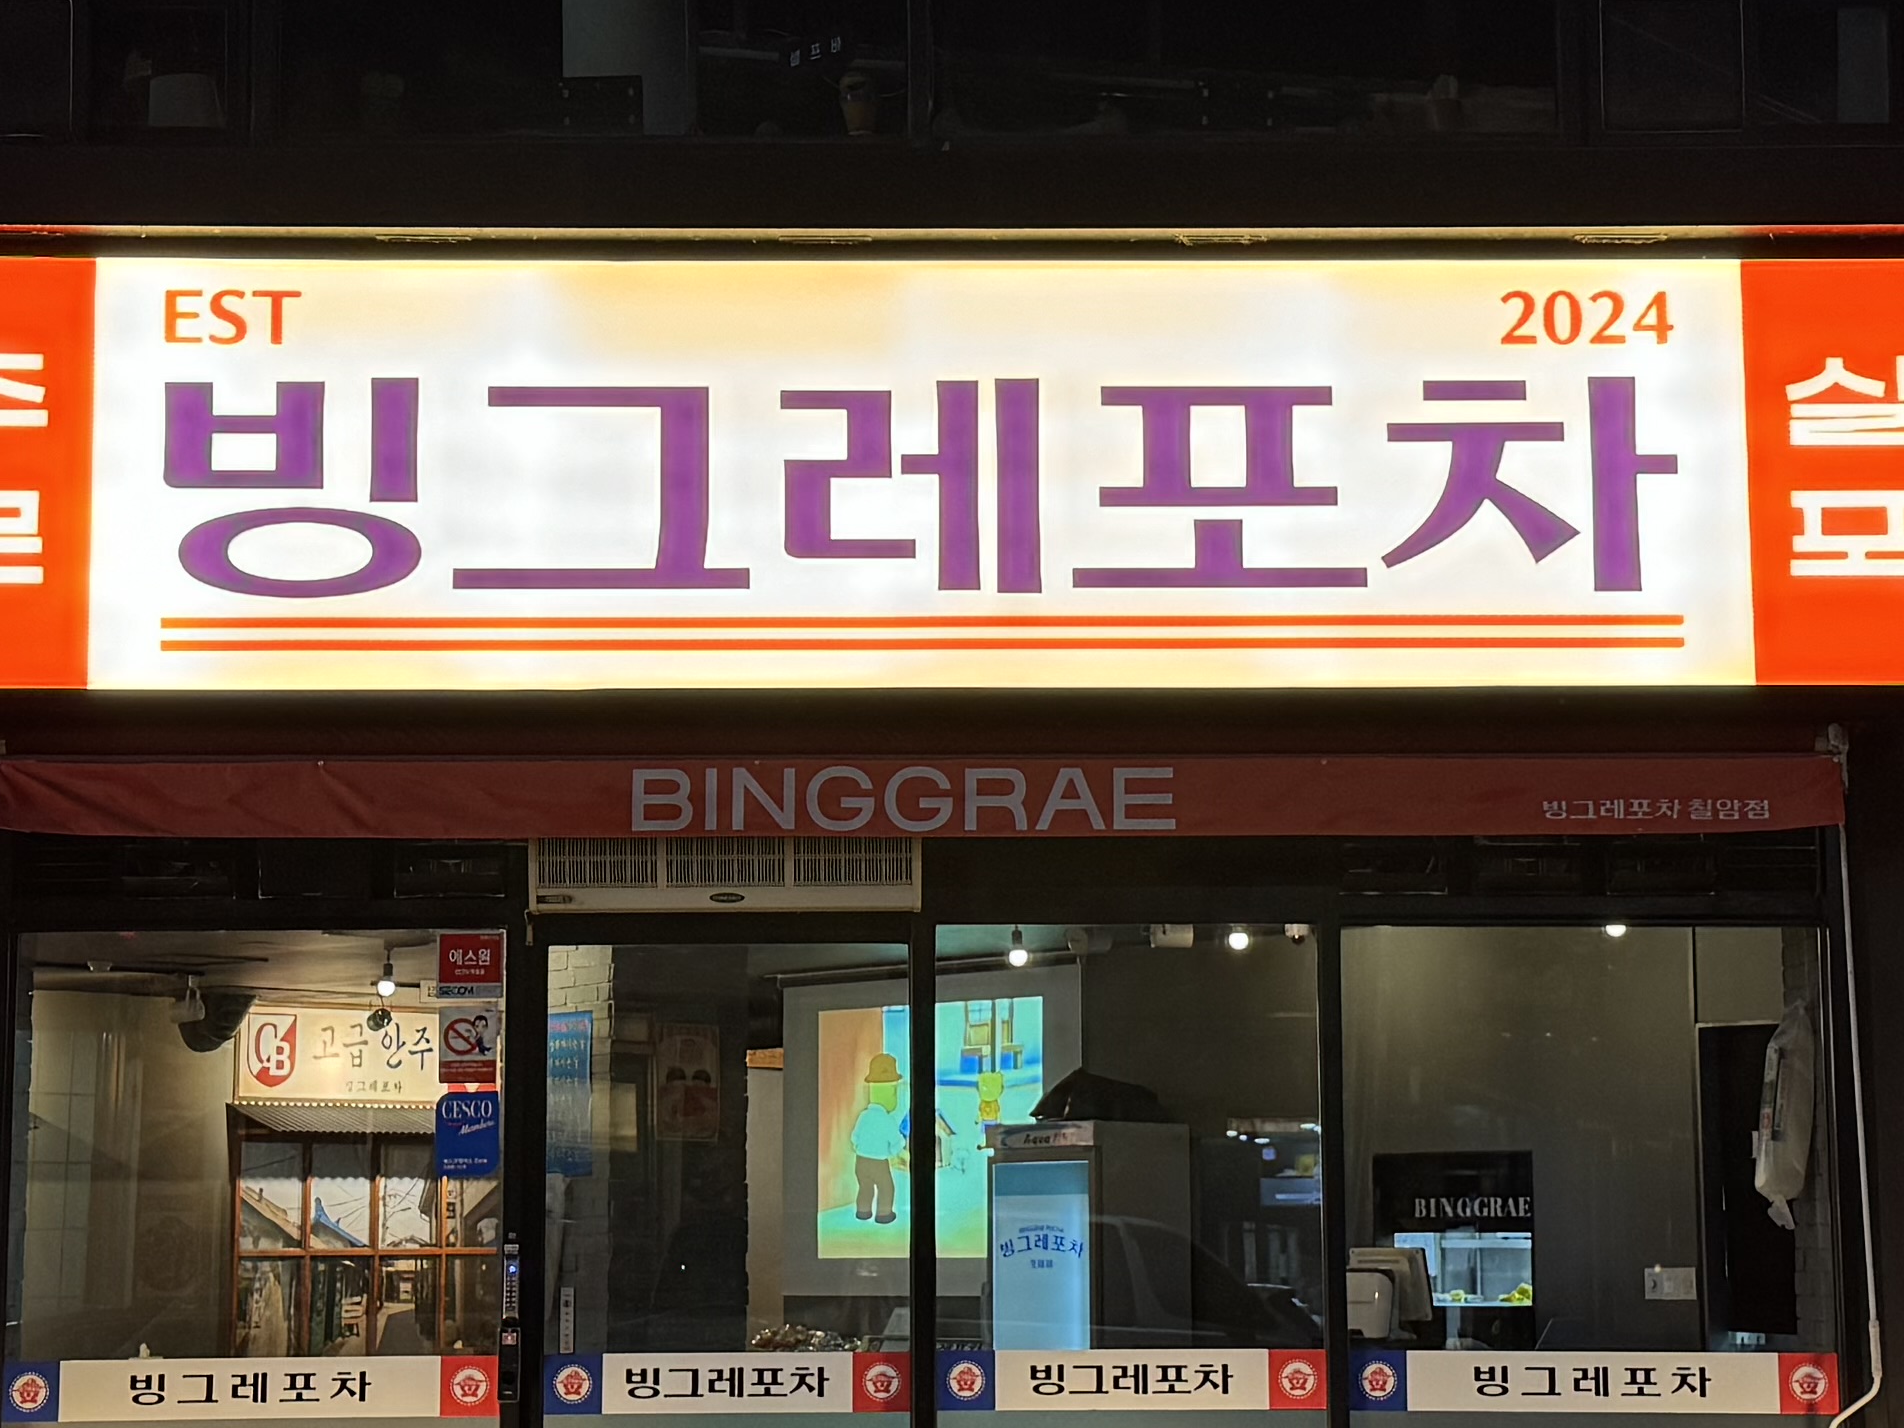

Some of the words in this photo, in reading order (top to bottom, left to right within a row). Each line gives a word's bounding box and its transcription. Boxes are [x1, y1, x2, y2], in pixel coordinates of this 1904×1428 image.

[163, 287, 303, 346] EST
[1498, 288, 1676, 346] 2024
[161, 374, 1679, 599] 빙그레포차
[631, 765, 1178, 833] BINGGRAE
[1540, 793, 1682, 823] 빙그레포차
[1685, 792, 1772, 823] 칠암점
[448, 948, 492, 966] 에스원
[441, 1099, 493, 1120] CESCO
[1413, 1193, 1533, 1221] BINGGRAE
[127, 1369, 373, 1407] 빙그레포차
[624, 1363, 831, 1401] 빙그레포차
[1028, 1359, 1236, 1398] 빙그레포차
[1473, 1361, 1714, 1400] 빙그레포차
